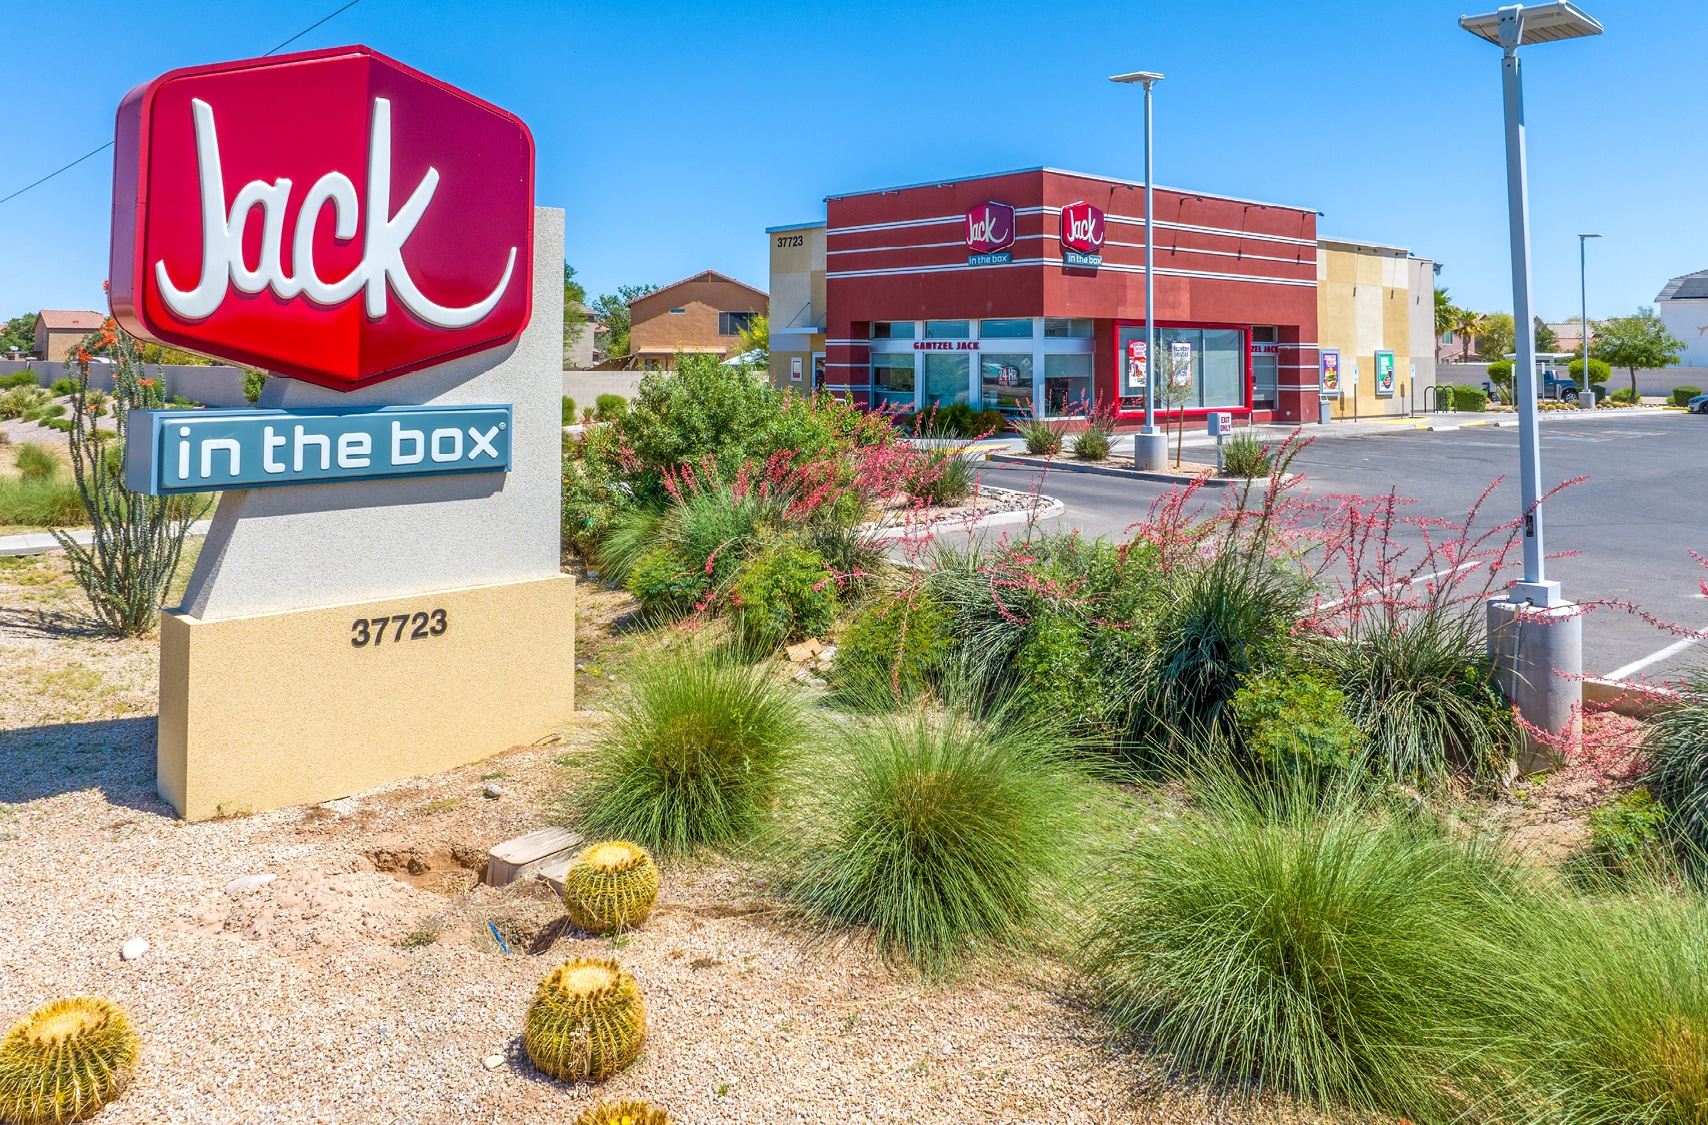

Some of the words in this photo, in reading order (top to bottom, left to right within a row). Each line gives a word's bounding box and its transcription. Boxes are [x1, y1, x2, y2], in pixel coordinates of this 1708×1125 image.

[156, 97, 517, 329] Jack
[966, 207, 1009, 245] Jack
[1066, 207, 1104, 246] Jack
[777, 235, 804, 248] 37723
[969, 256, 977, 265] in
[978, 255, 991, 264] the
[992, 254, 1008, 263] box
[1068, 254, 1076, 263] in
[1076, 255, 1088, 264] the
[1089, 256, 1102, 265] box
[913, 341, 954, 350] GANTZEL
[956, 341, 980, 350] JACK
[1221, 416, 1230, 424] EXIT
[178, 426, 241, 480] in
[264, 424, 373, 474] the
[351, 608, 448, 649] 37723
